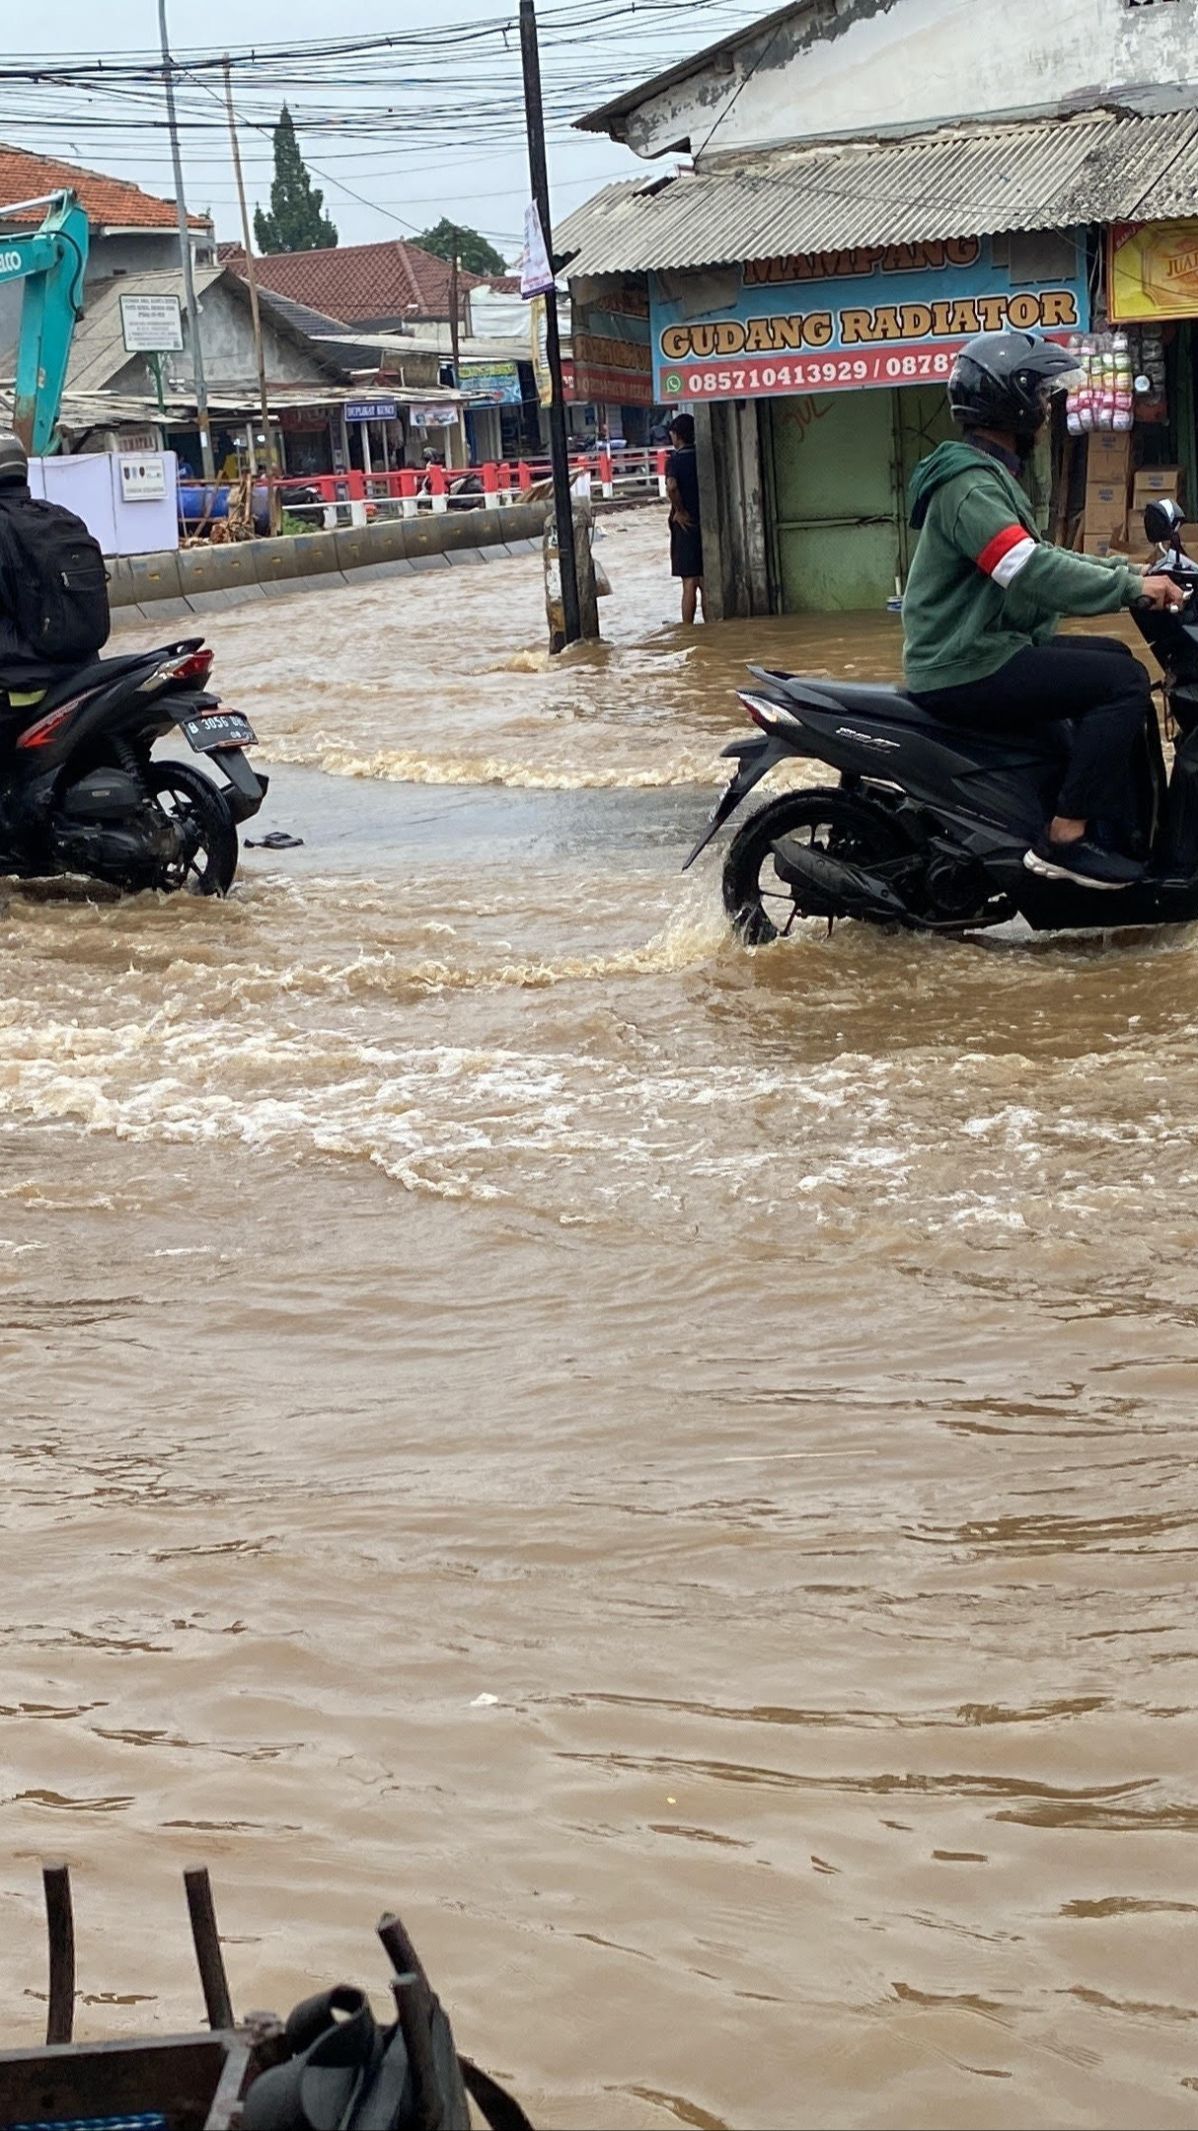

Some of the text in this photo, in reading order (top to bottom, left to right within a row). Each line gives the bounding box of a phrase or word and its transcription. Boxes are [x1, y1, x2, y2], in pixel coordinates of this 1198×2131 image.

[743, 234, 980, 285] MAMPANG
[661, 311, 834, 359] GUDANG
[841, 291, 1077, 344] RADIATOR
[688, 358, 868, 393] 085710413929
[873, 357, 881, 378] /
[188, 721, 199, 734] B
